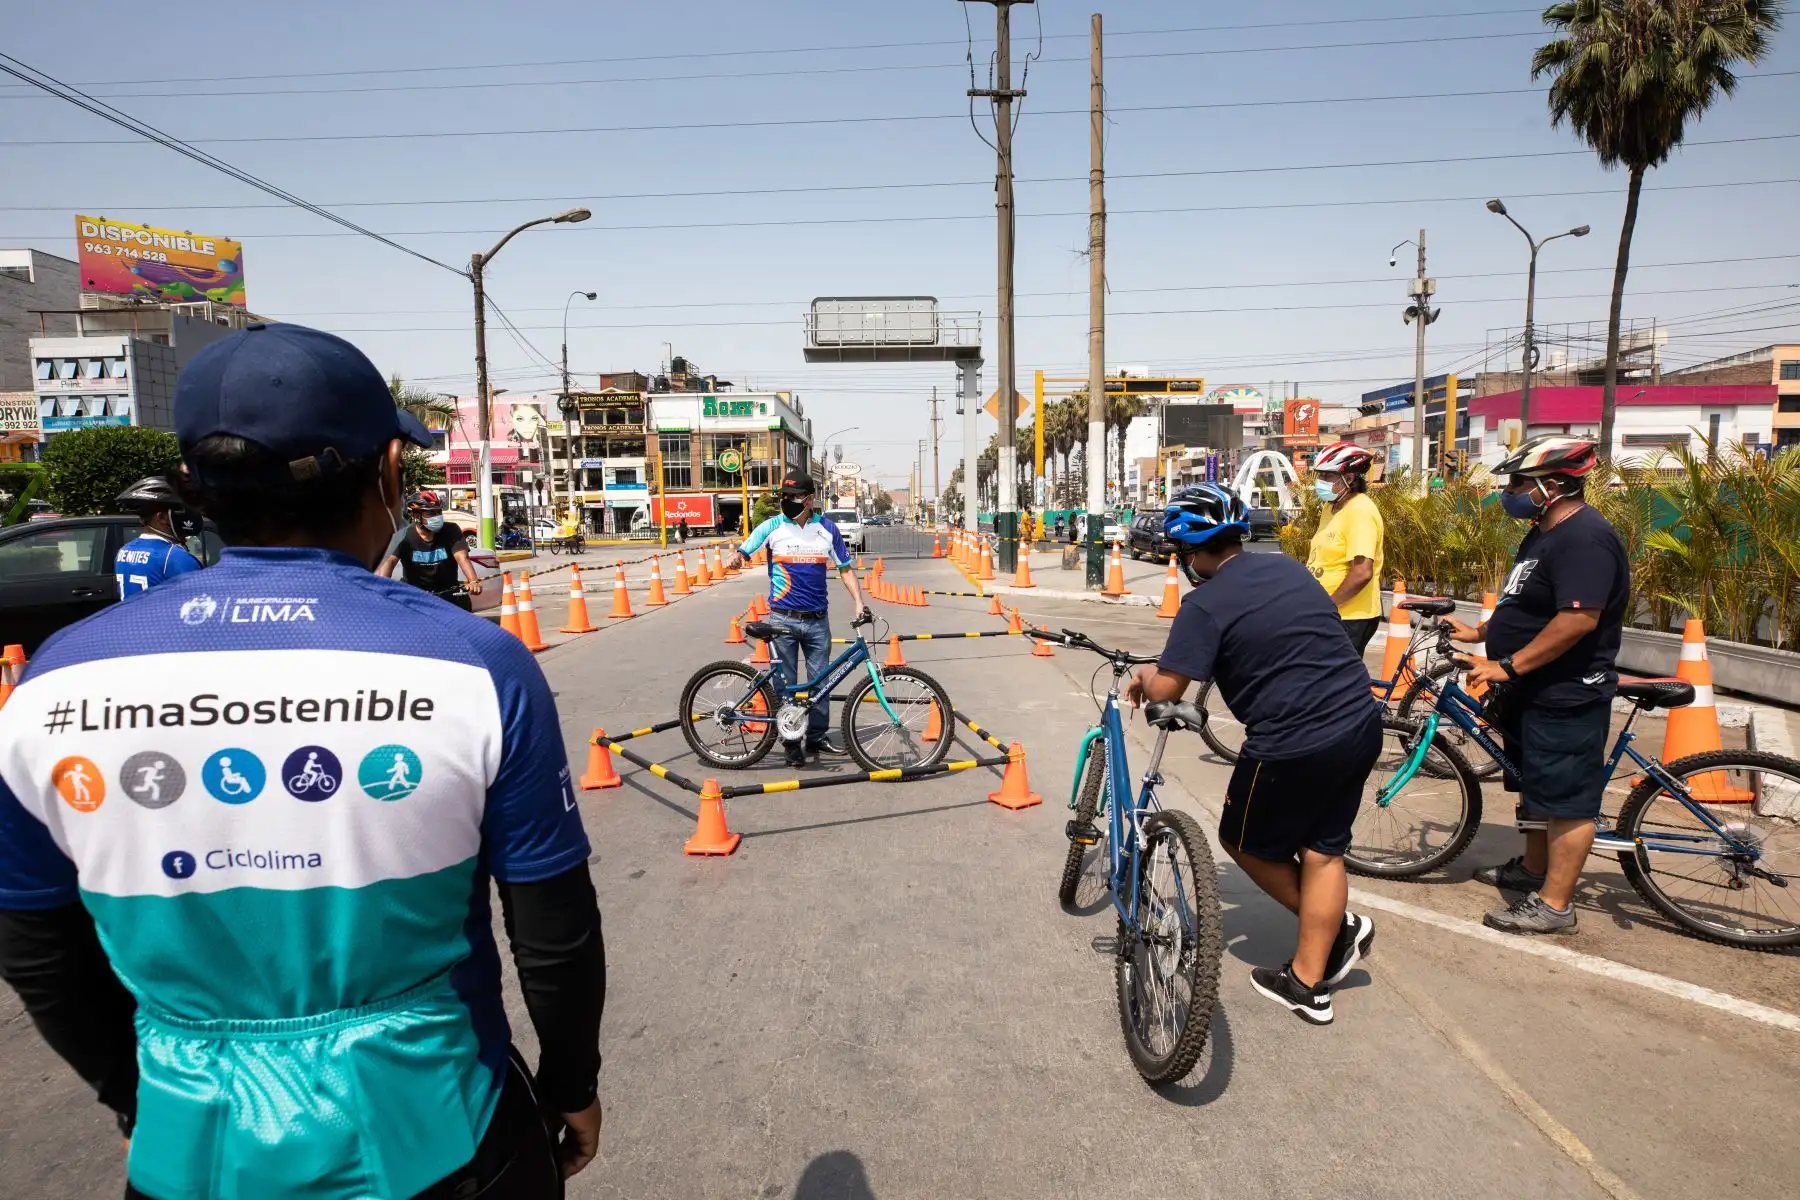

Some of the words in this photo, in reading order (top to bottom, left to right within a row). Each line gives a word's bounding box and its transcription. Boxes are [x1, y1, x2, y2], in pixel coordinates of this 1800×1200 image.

[81, 221, 215, 256] DISPONIBLE
[84, 242, 112, 255] 963
[115, 246, 139, 259] 714
[142, 251, 167, 263] 528
[0, 399, 36, 407] ONSTRUY
[4, 421, 21, 430] 992
[22, 420, 39, 429] 922
[665, 510, 701, 519] Redondos
[231, 604, 315, 623] LIMA
[44, 690, 434, 734] #LimaSostenible
[1479, 734, 1521, 777] MUNICIPALIDAD
[205, 848, 322, 870] Ciclolima
